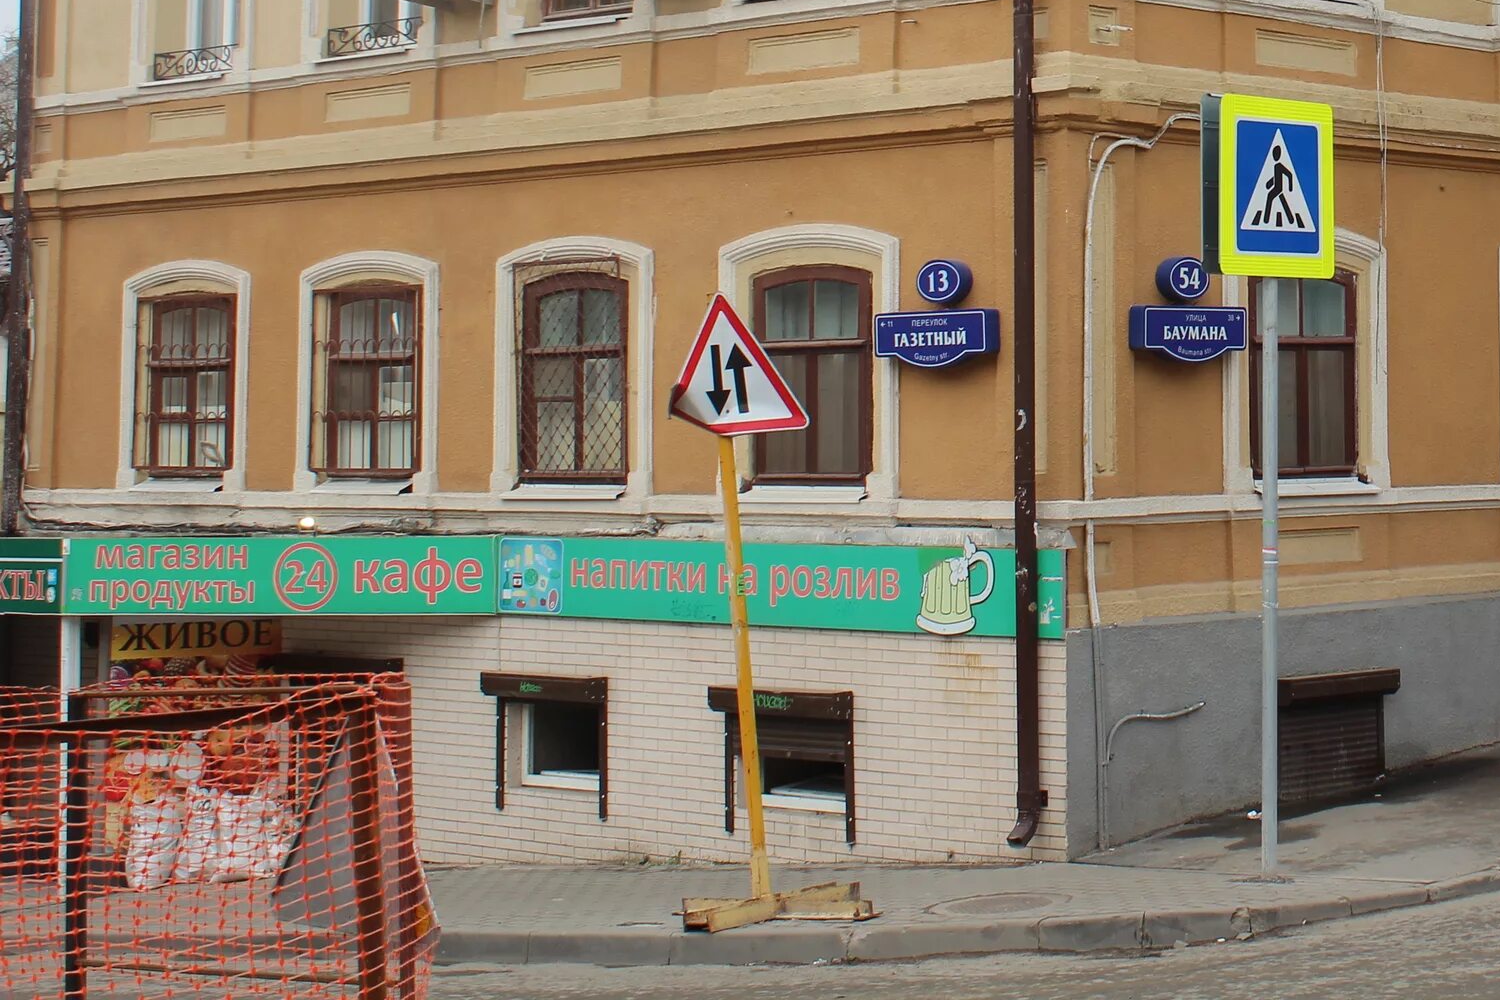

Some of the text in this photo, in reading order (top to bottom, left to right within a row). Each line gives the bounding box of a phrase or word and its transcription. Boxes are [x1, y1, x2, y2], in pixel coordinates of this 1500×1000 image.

[928, 269, 950, 293] 13
[1179, 267, 1201, 290] 54
[911, 318, 948, 327] ПЕРЕУЛОК
[1185, 314, 1207, 323] УЛИЦА
[894, 327, 967, 348] ГАЗЕТНЫЙ
[1163, 326, 1228, 341] БАУМАНА
[914, 352, 939, 362] Gazetny
[95, 544, 249, 569] магазин
[283, 559, 329, 594] 24
[353, 546, 484, 605] кафе
[570, 557, 707, 594] напитки
[769, 564, 900, 607] розлив
[89, 578, 256, 610] продукты
[118, 618, 274, 652] ЖИВОЕ
